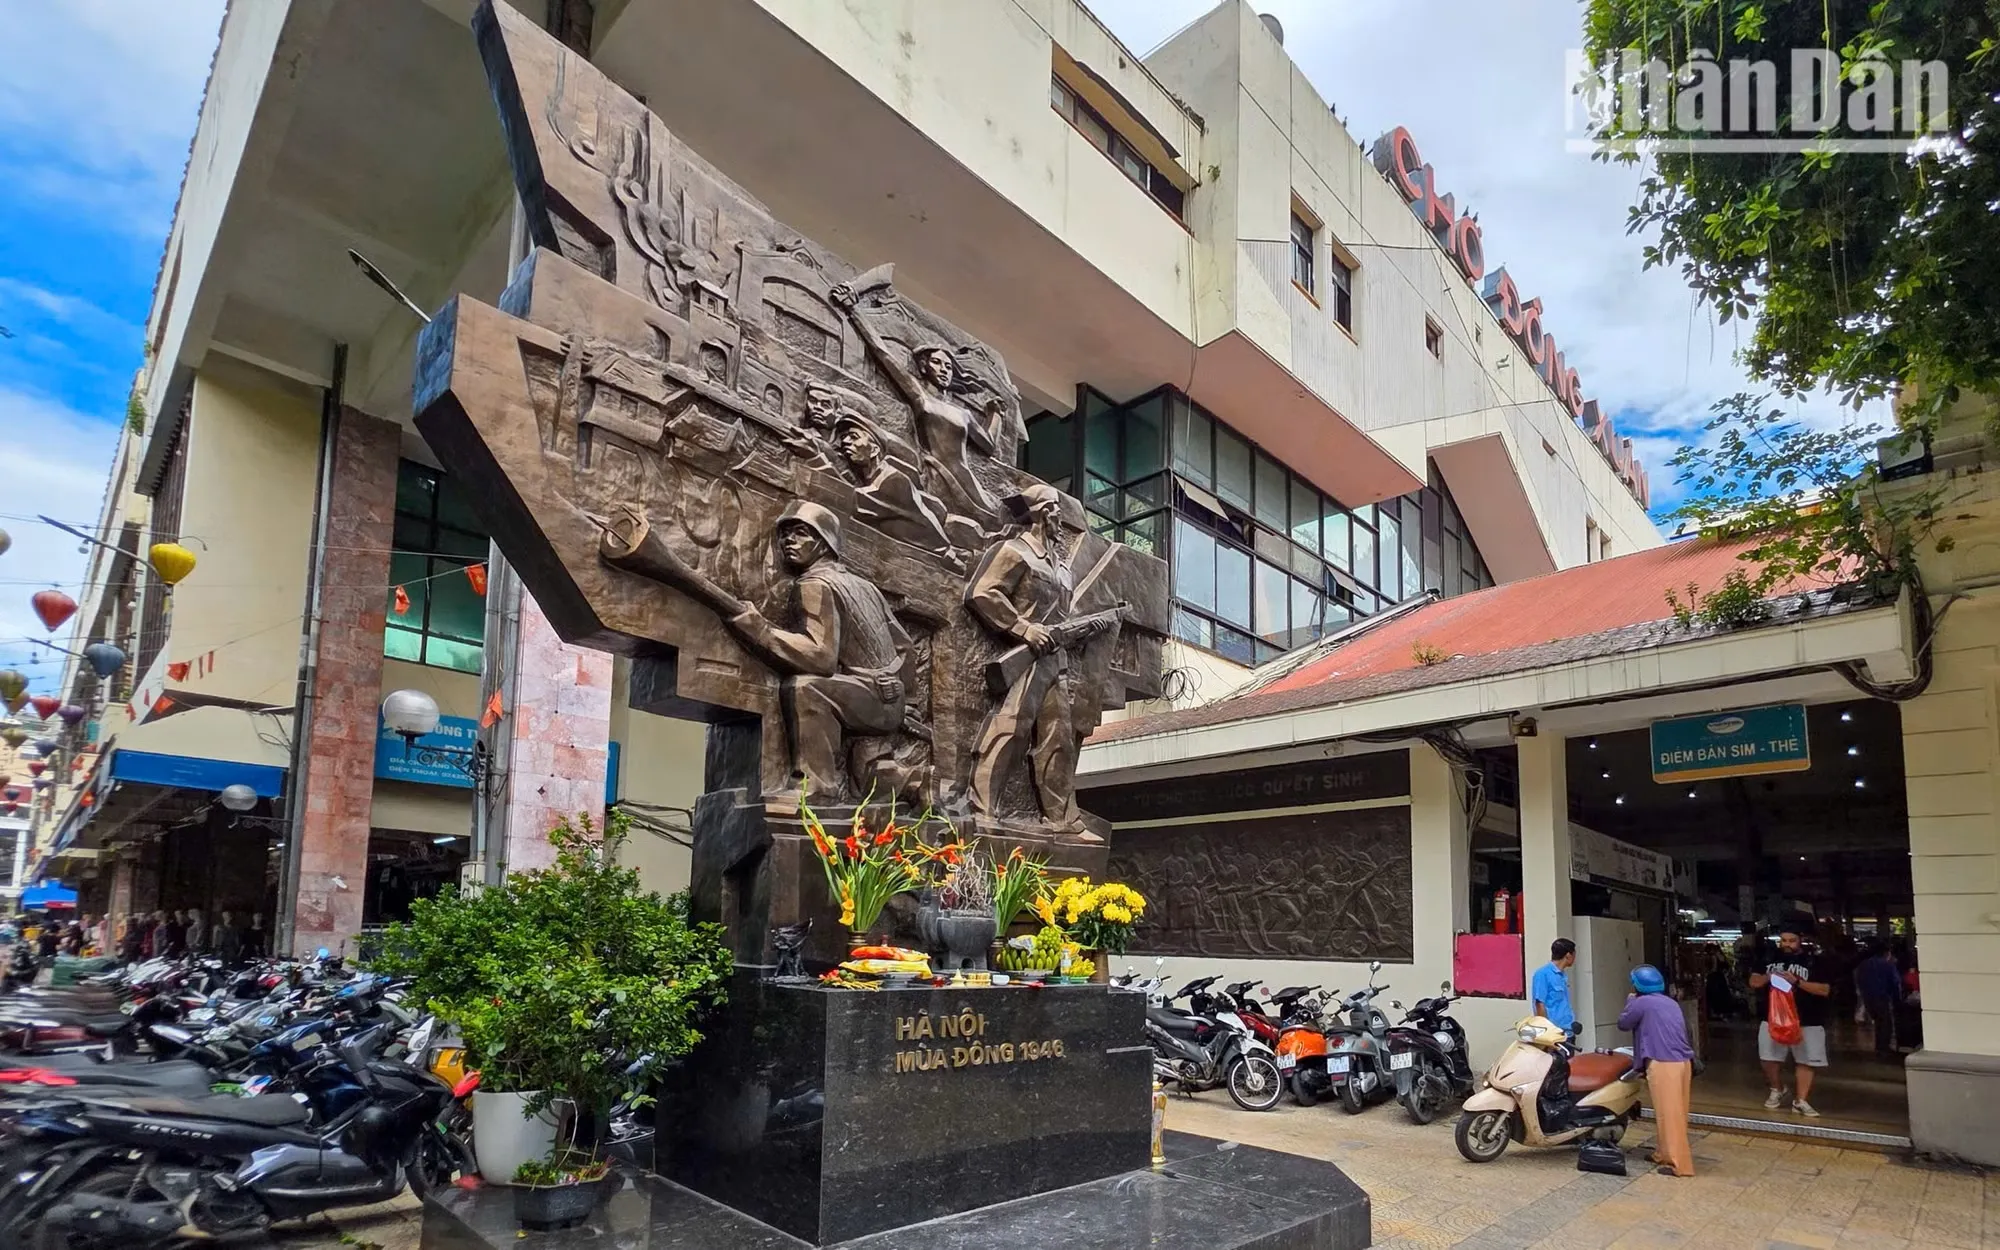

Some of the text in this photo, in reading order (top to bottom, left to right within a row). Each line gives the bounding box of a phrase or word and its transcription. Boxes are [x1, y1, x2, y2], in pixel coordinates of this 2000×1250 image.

[1660, 745, 1694, 765] ĐIỂM
[1697, 744, 1727, 761] BÁN
[1730, 742, 1756, 757] SIM
[1766, 962, 1786, 974] THE
[895, 1006, 986, 1042] HÀ NỘI
[895, 1038, 1065, 1074] MÙA ĐÔNG 1946
